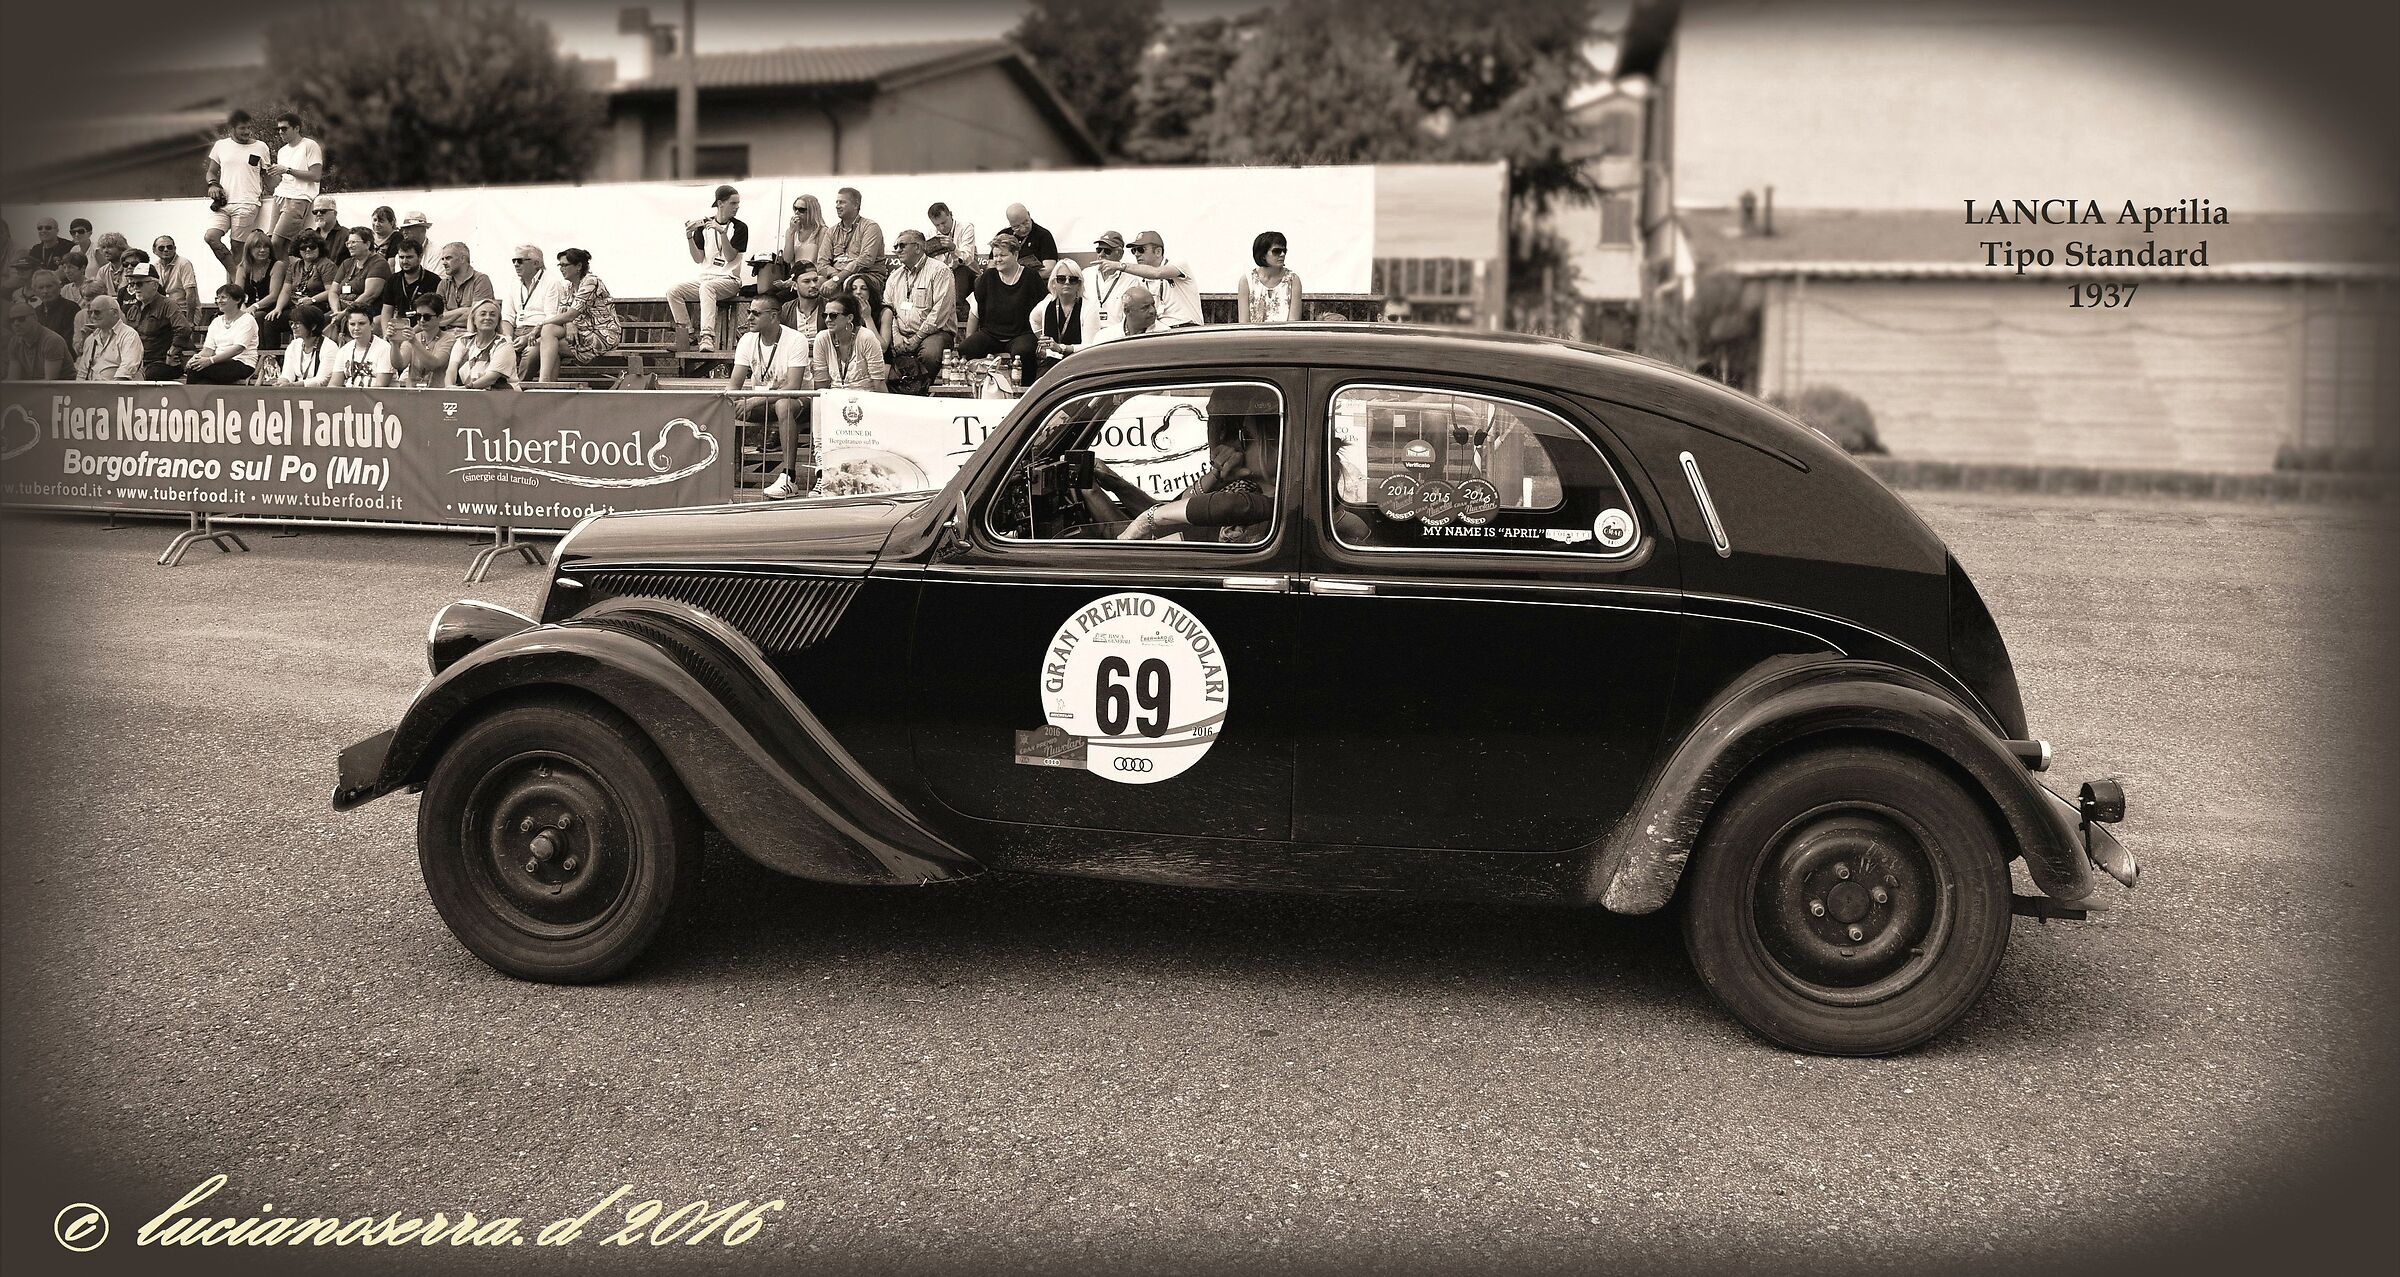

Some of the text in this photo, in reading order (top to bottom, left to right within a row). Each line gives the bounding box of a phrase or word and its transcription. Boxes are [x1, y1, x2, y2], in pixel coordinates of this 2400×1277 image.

[51, 395, 402, 449] Fiera Nazionale del Tartufo
[455, 427, 644, 466] TuberFood
[63, 448, 391, 492] Borgofranco sul Po (Mn)
[462, 472, 539, 488] (sinergie dal tartufo)
[1148, 463, 1213, 494] Tartuf
[116, 484, 246, 504] www.tuberfood.it
[1387, 485, 1415, 496] 2014
[1422, 492, 1451, 503] 2015
[1462, 488, 1491, 503] 2016
[261, 491, 403, 511] www.tuberfood.it
[1386, 509, 1415, 520] PASSED
[1421, 515, 1450, 526] PASSED
[1457, 511, 1486, 525] PASSED
[1423, 526, 1546, 539] MY NAME IS “APRIL”
[1046, 597, 1225, 704] GRAN PREMIO NUVOLARI
[1095, 655, 1171, 738] 69
[1044, 726, 1061, 737] 2016
[1192, 726, 1213, 737] 2016
[1043, 736, 1085, 757] Nuvolari
